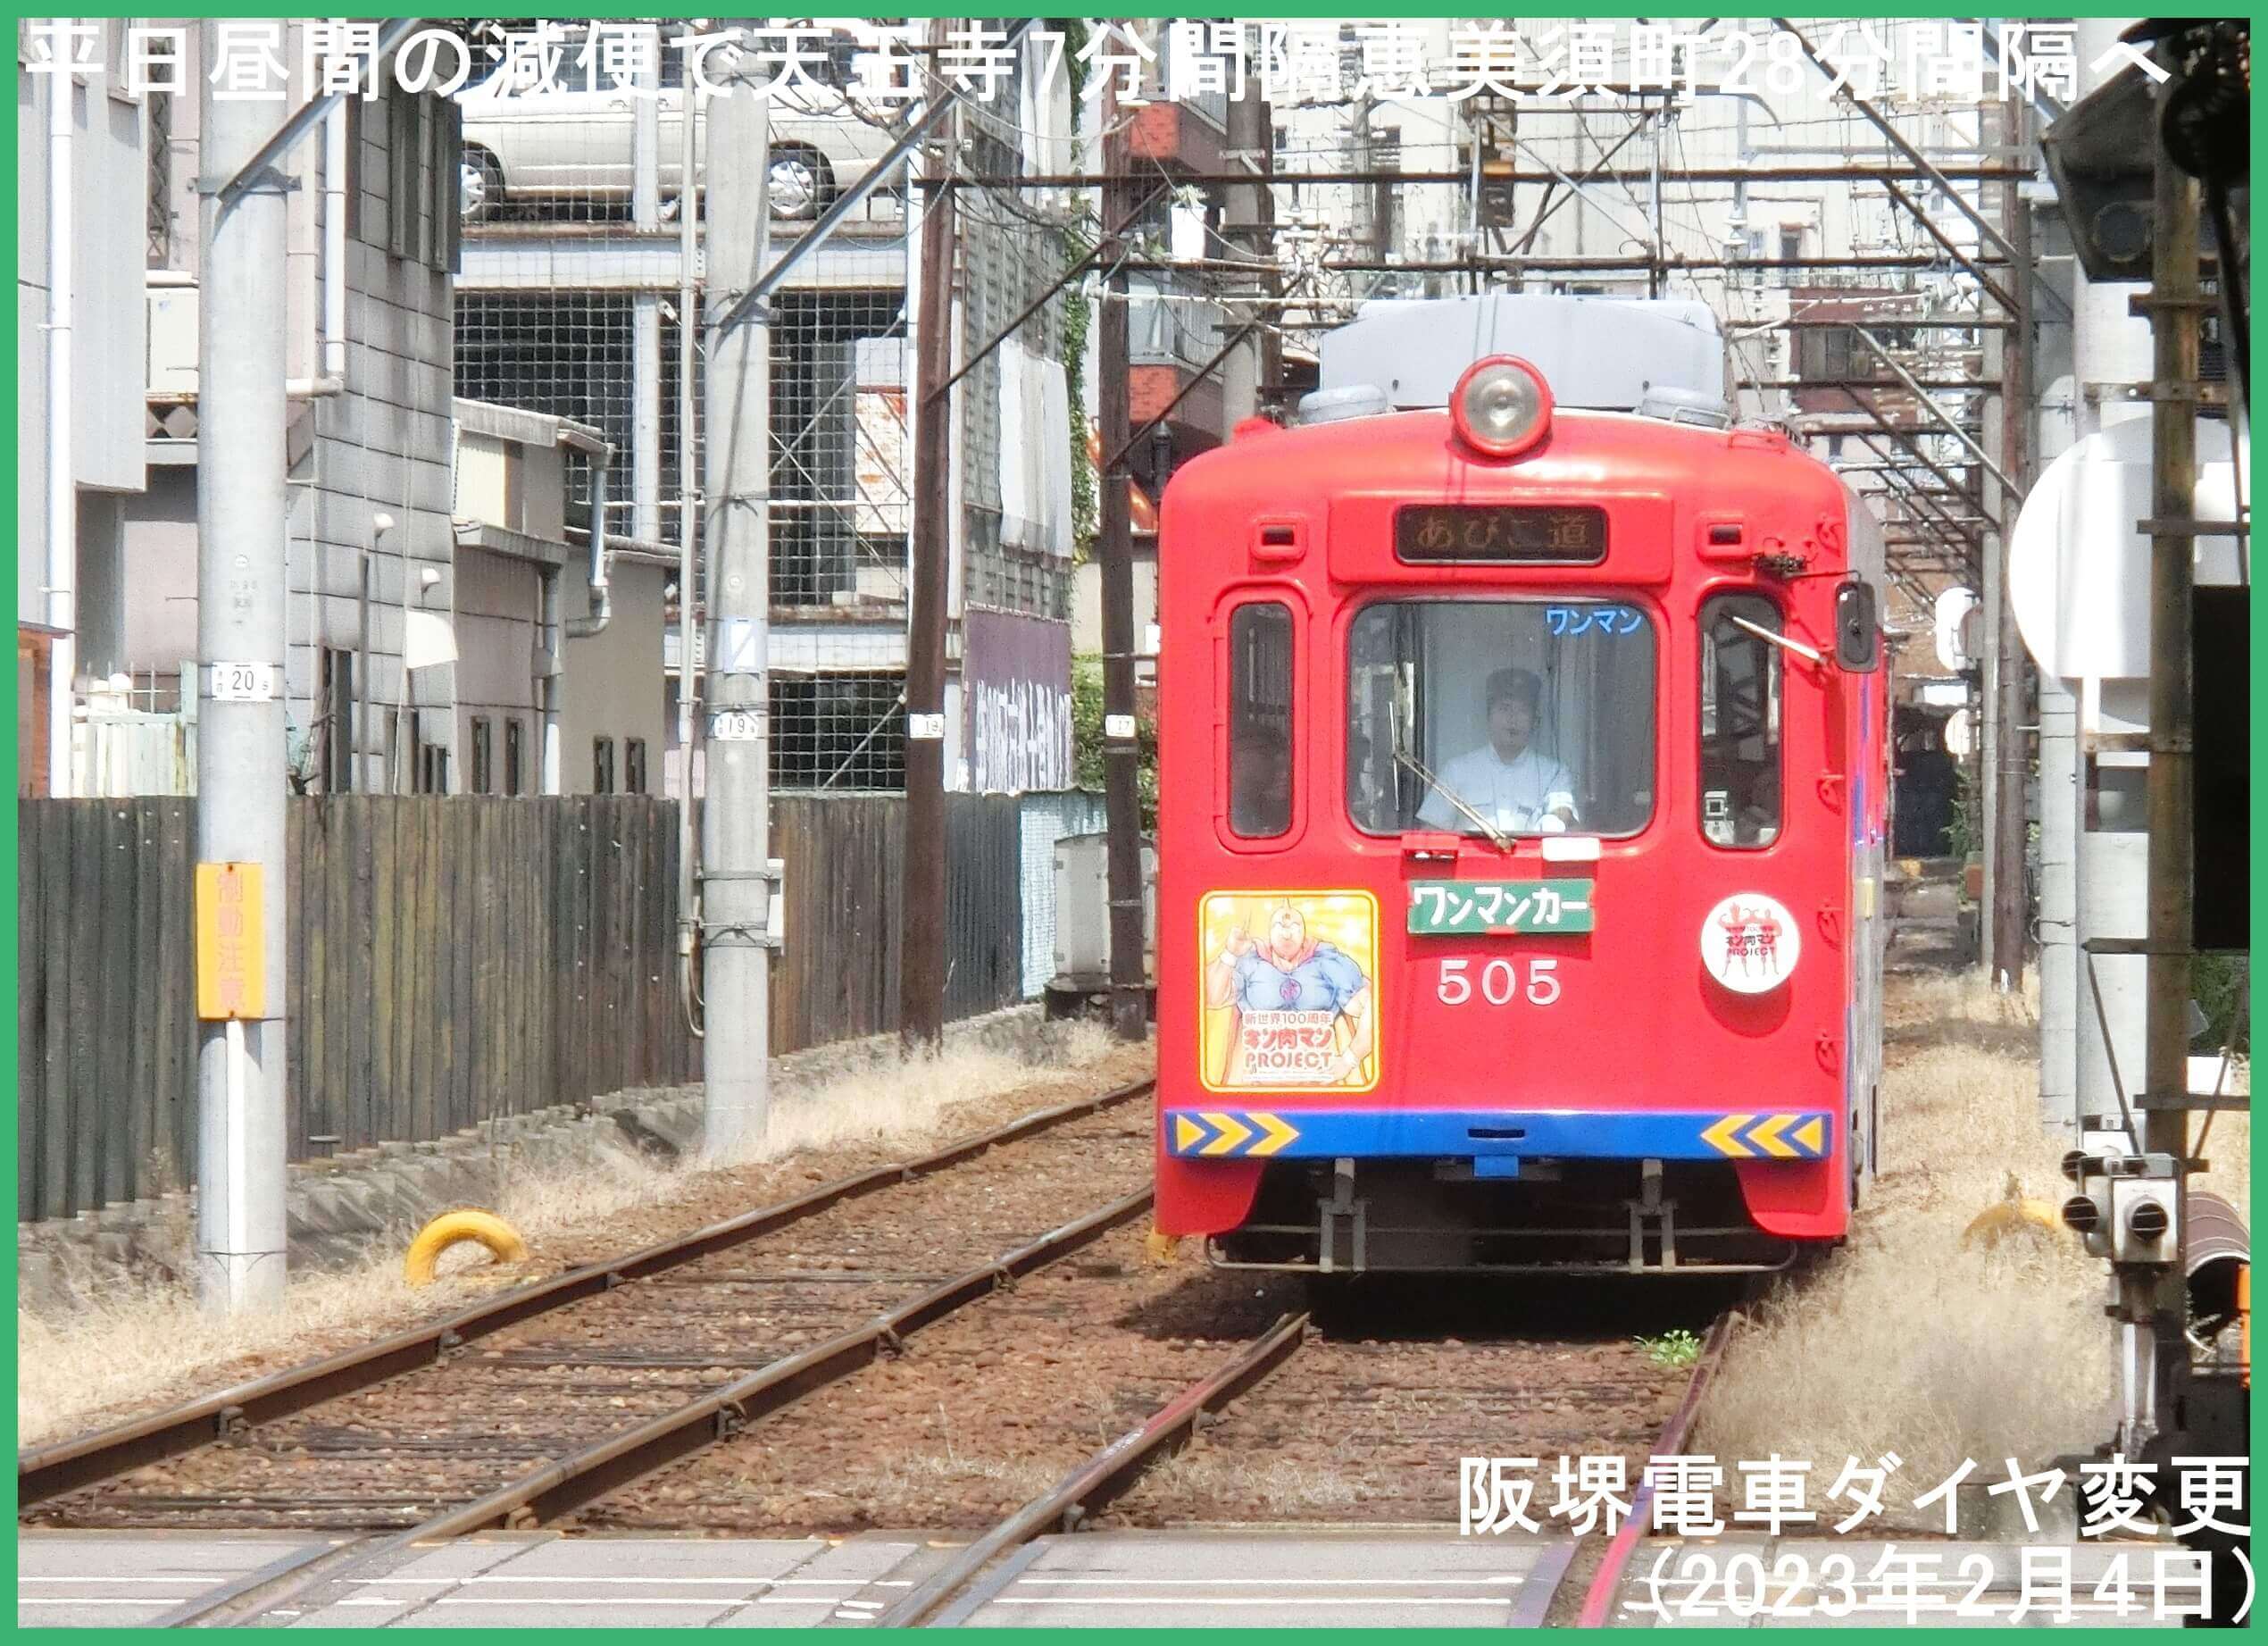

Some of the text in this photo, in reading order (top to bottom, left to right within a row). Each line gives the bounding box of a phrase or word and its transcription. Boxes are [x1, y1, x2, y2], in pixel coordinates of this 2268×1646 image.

[1546, 608, 1641, 635] ワンマン
[232, 671, 254, 691] 20
[729, 718, 745, 733] 19
[1413, 886, 1588, 925] ワンマンカー
[1437, 960, 1561, 1006] 505
[1246, 1052, 1332, 1067] PROJECT
